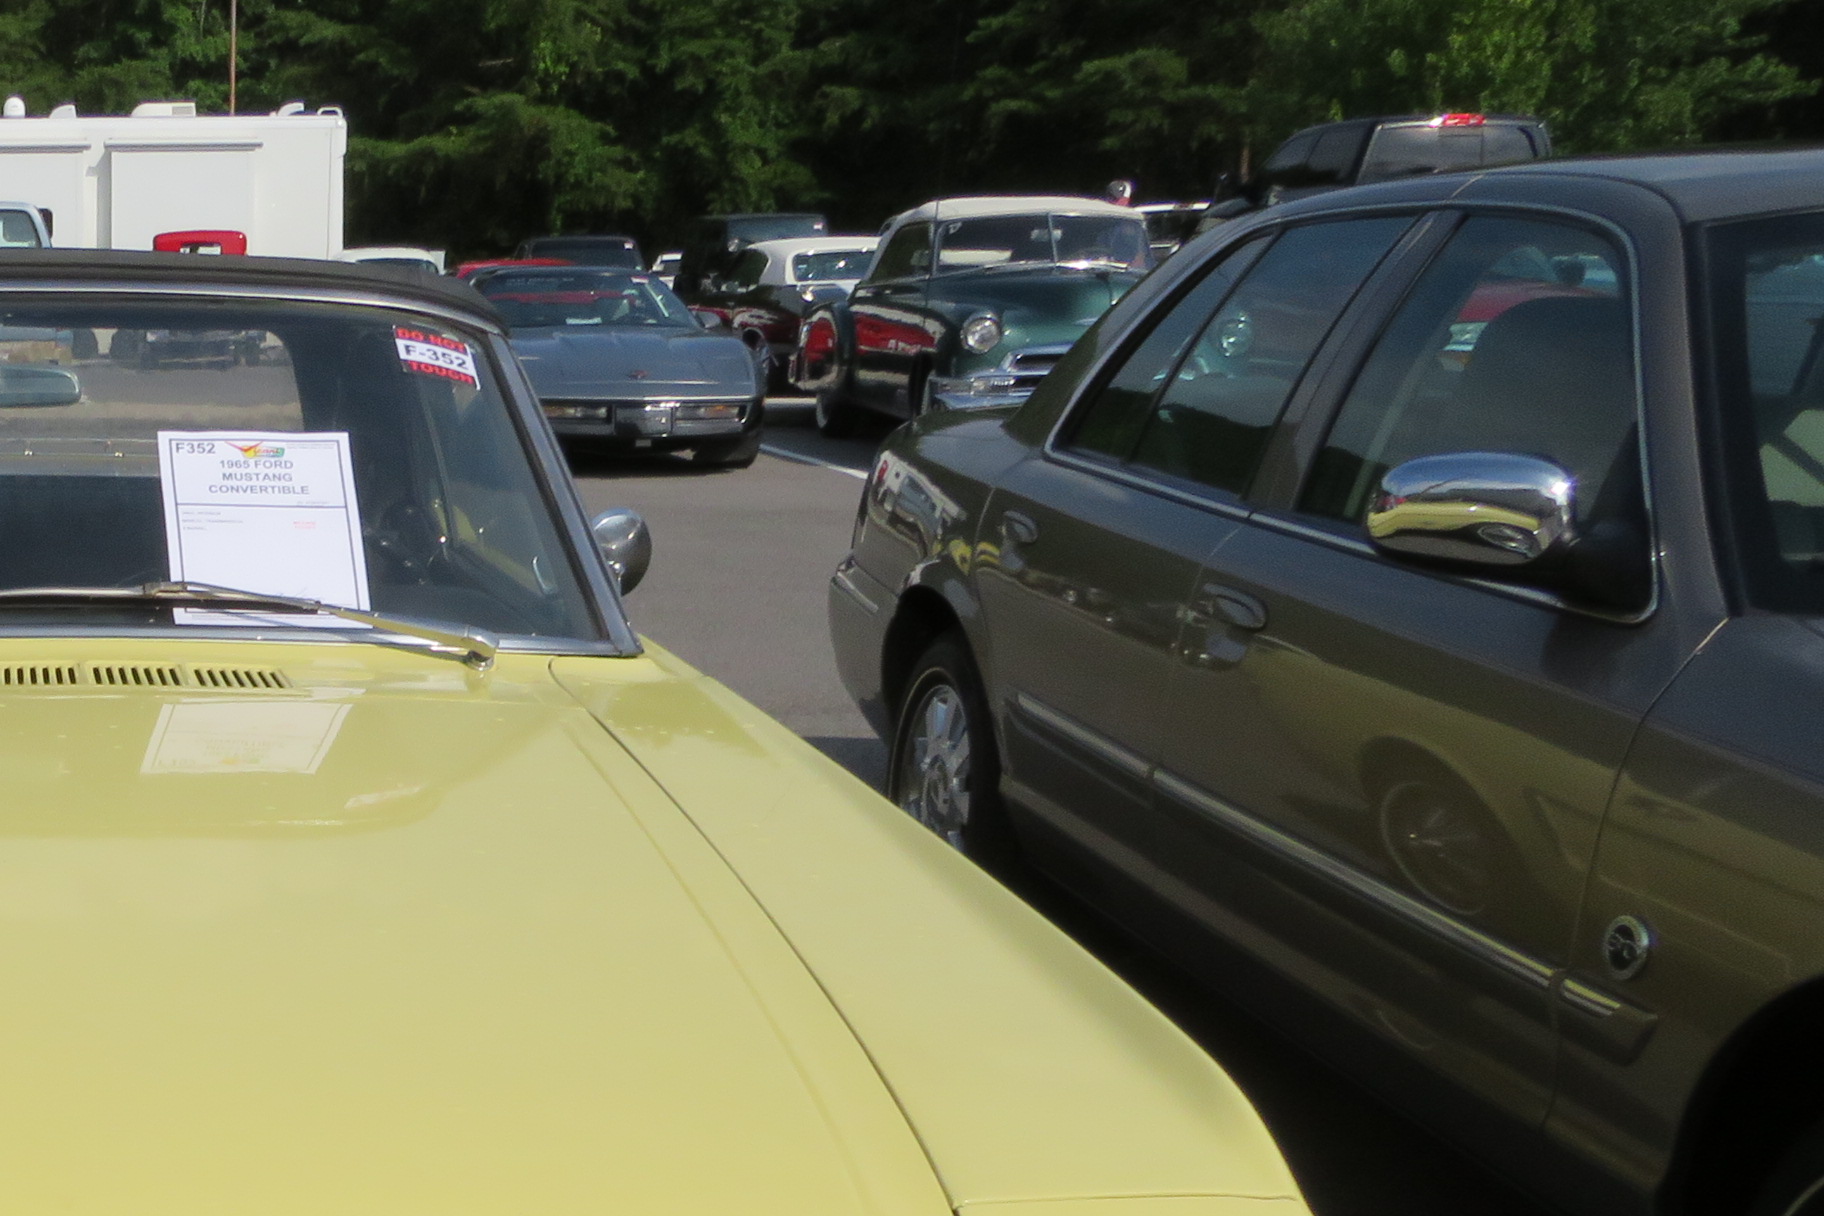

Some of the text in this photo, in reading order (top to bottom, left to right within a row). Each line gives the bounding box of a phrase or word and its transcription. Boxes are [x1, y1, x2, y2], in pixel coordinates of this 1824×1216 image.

[396, 328, 467, 354] DO NOT
[404, 344, 469, 371] F-352
[175, 442, 216, 455] F352
[219, 459, 294, 470] 1965 FORD
[222, 472, 293, 482] MUSTANG
[208, 484, 310, 495] CONVERTIBLE
